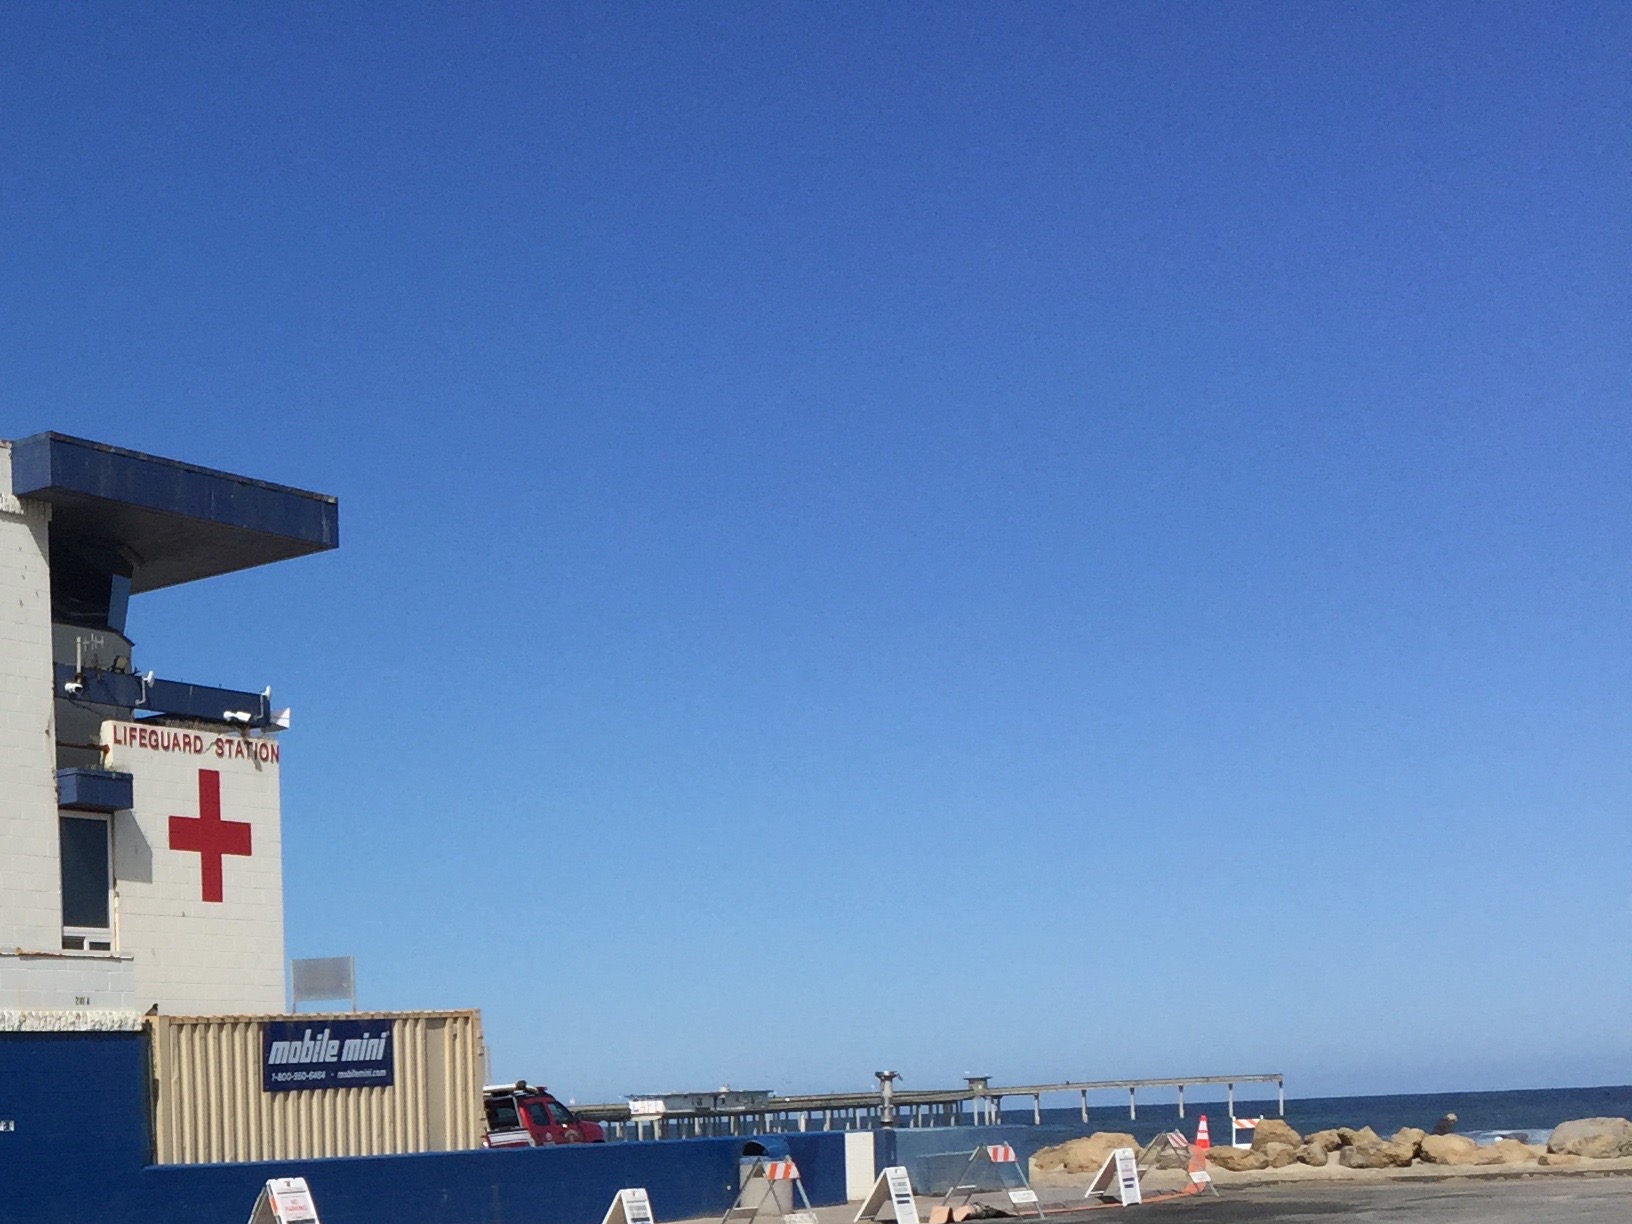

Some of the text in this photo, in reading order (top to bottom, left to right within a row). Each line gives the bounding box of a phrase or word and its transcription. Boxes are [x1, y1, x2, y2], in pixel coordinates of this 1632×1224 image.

[113, 725, 279, 763] LIFEGUARD STATION
[268, 1029, 387, 1064] mobile mini
